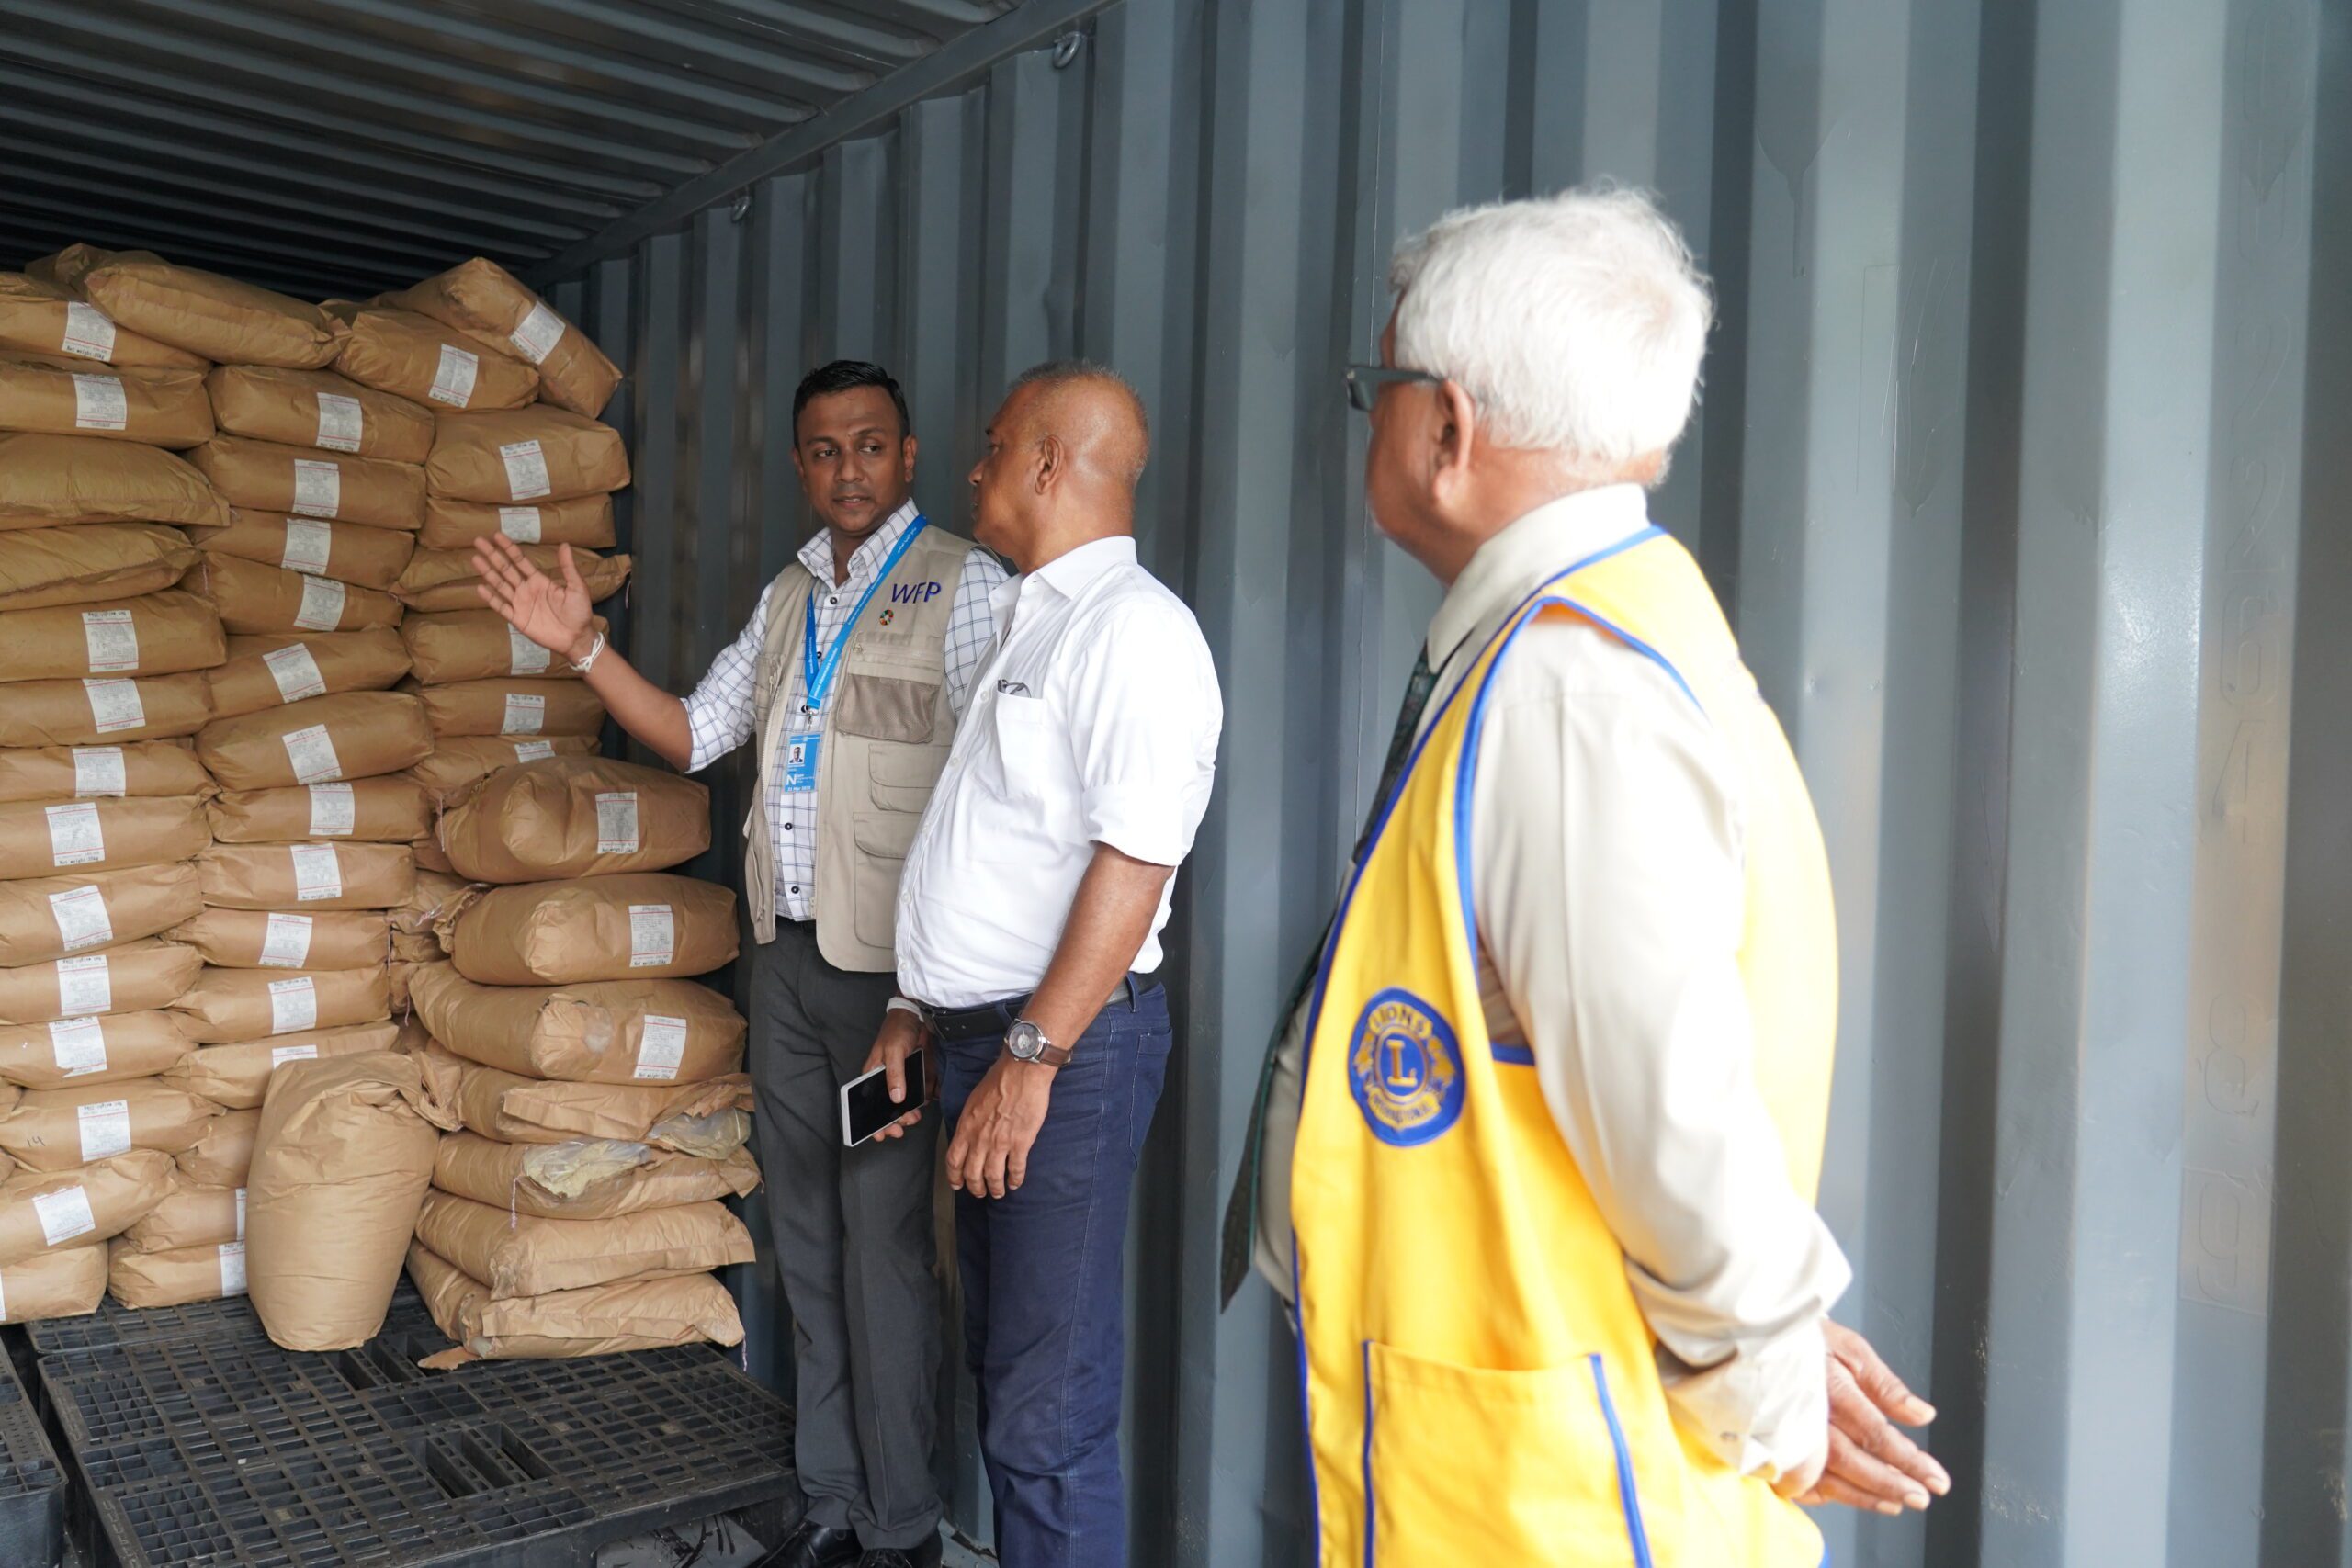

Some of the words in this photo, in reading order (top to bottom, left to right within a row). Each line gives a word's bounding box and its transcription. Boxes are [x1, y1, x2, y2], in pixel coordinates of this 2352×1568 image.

[891, 581, 942, 604] WFP
[1371, 1005, 1425, 1033] LIONS
[1385, 1039, 1418, 1087] L
[27, 1135, 45, 1147] 14
